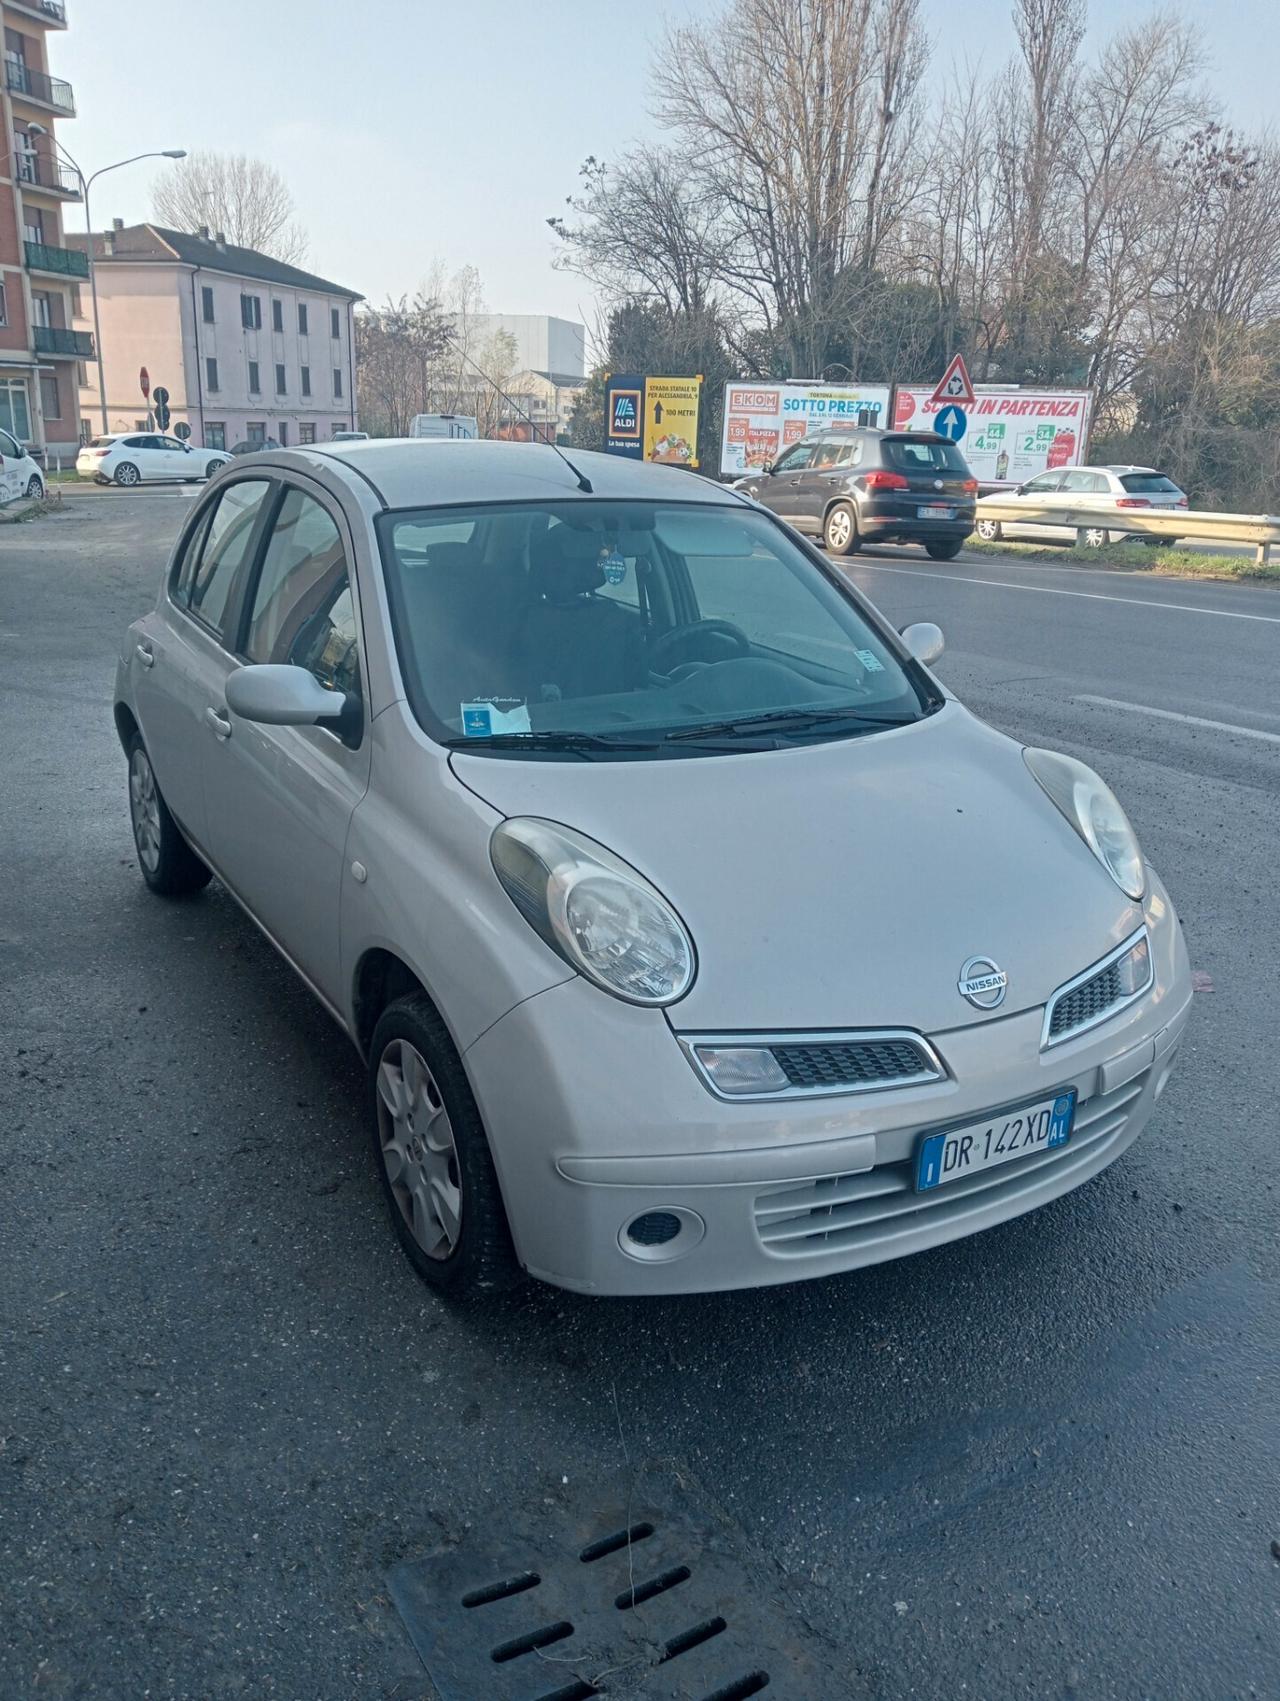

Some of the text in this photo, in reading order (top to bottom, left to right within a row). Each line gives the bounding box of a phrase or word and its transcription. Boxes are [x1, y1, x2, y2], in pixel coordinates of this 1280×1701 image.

[734, 394, 776, 405] EKOM
[784, 398, 825, 412] SOTTO
[977, 399, 998, 415] IN
[997, 400, 1080, 417] PARTENZA
[614, 418, 635, 428] ALDI
[975, 435, 997, 451] 4,99
[1023, 436, 1047, 452] 2,99
[966, 975, 1006, 992] NISSAN
[943, 1135, 974, 1173] DR
[983, 1109, 1052, 1160] 142XD
[1050, 1119, 1065, 1142] AL
